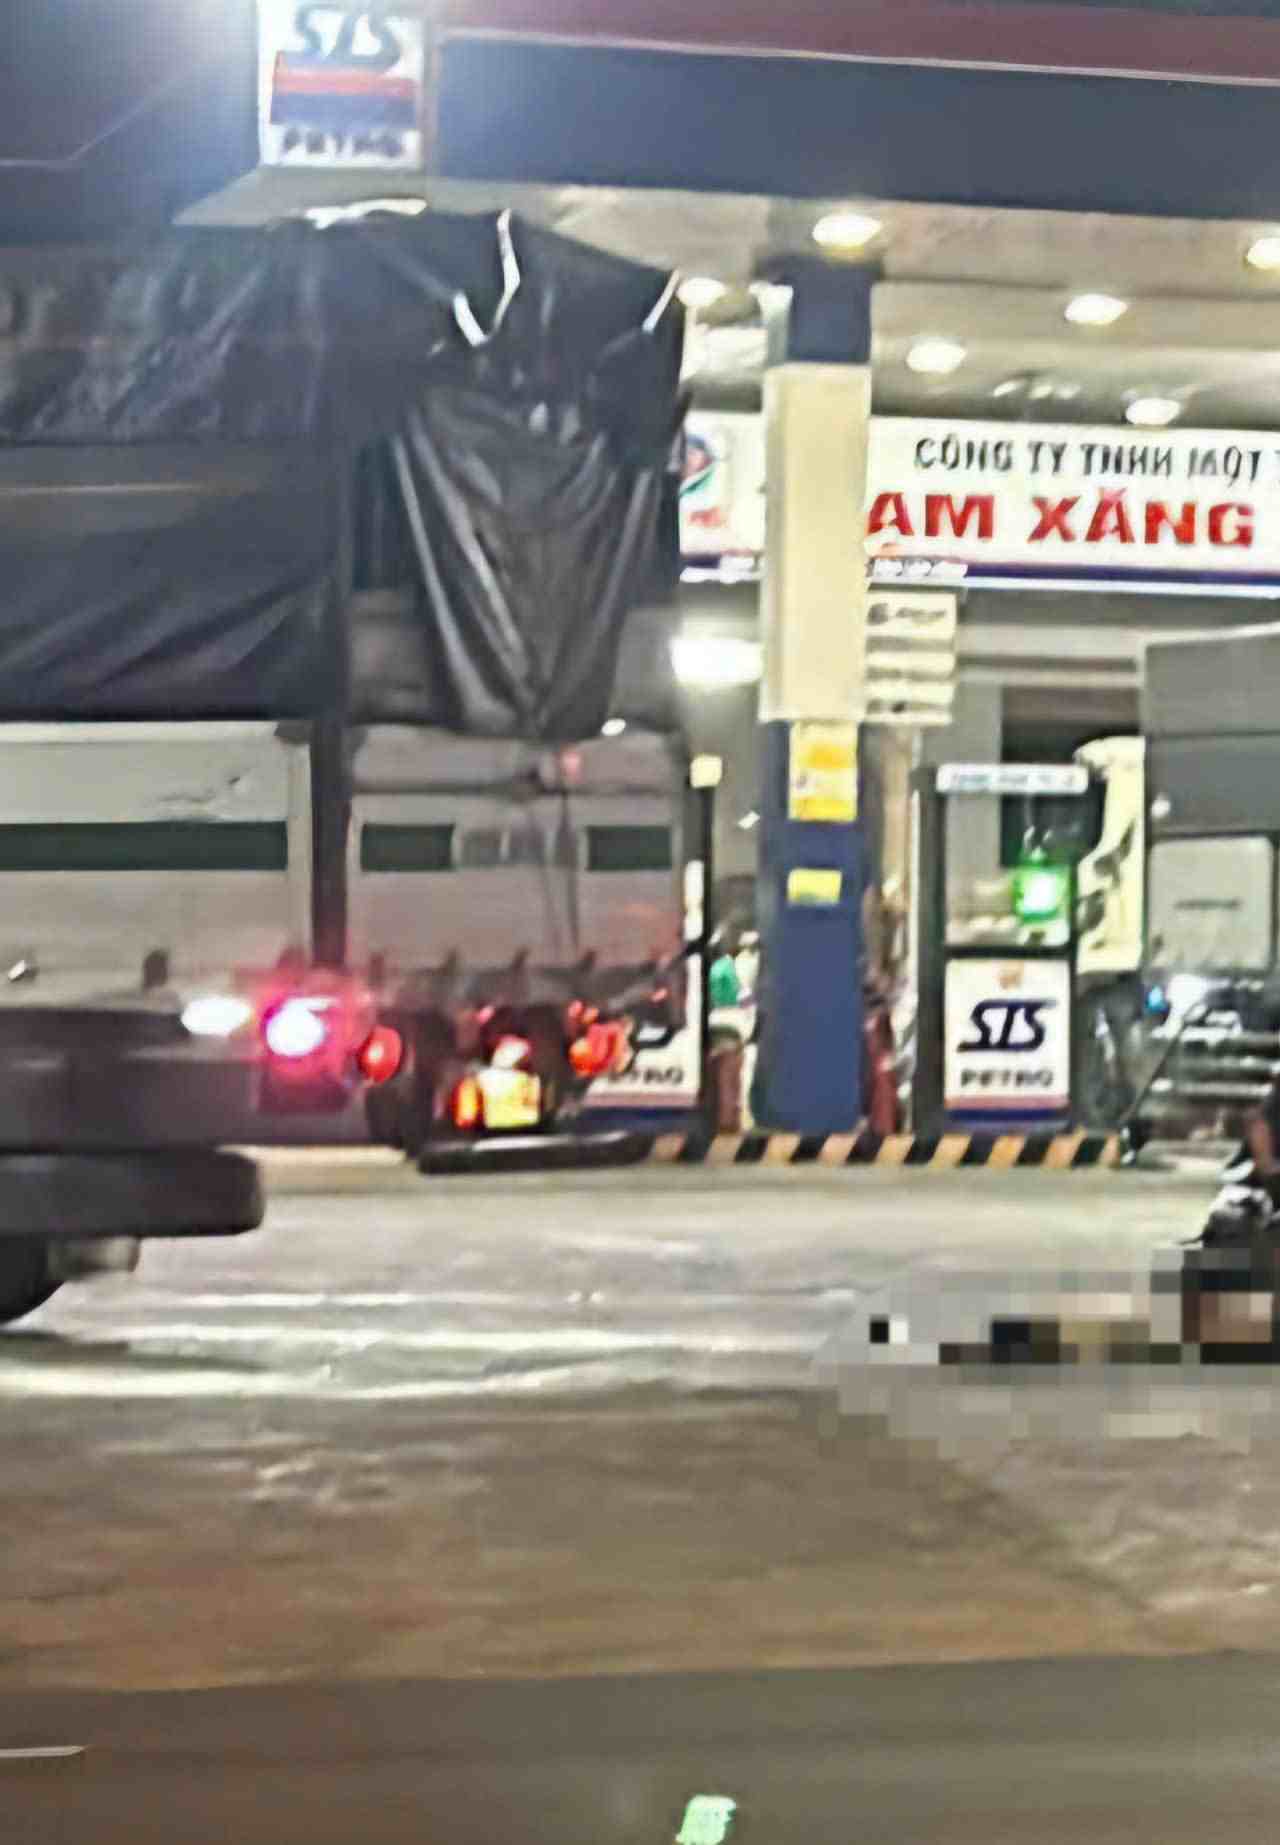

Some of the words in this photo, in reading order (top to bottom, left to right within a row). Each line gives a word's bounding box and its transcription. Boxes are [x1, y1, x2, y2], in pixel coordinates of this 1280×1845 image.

[1028, 441, 1067, 474] TY
[1027, 487, 1253, 546] XĂNG
[957, 999, 1057, 1052] STS
